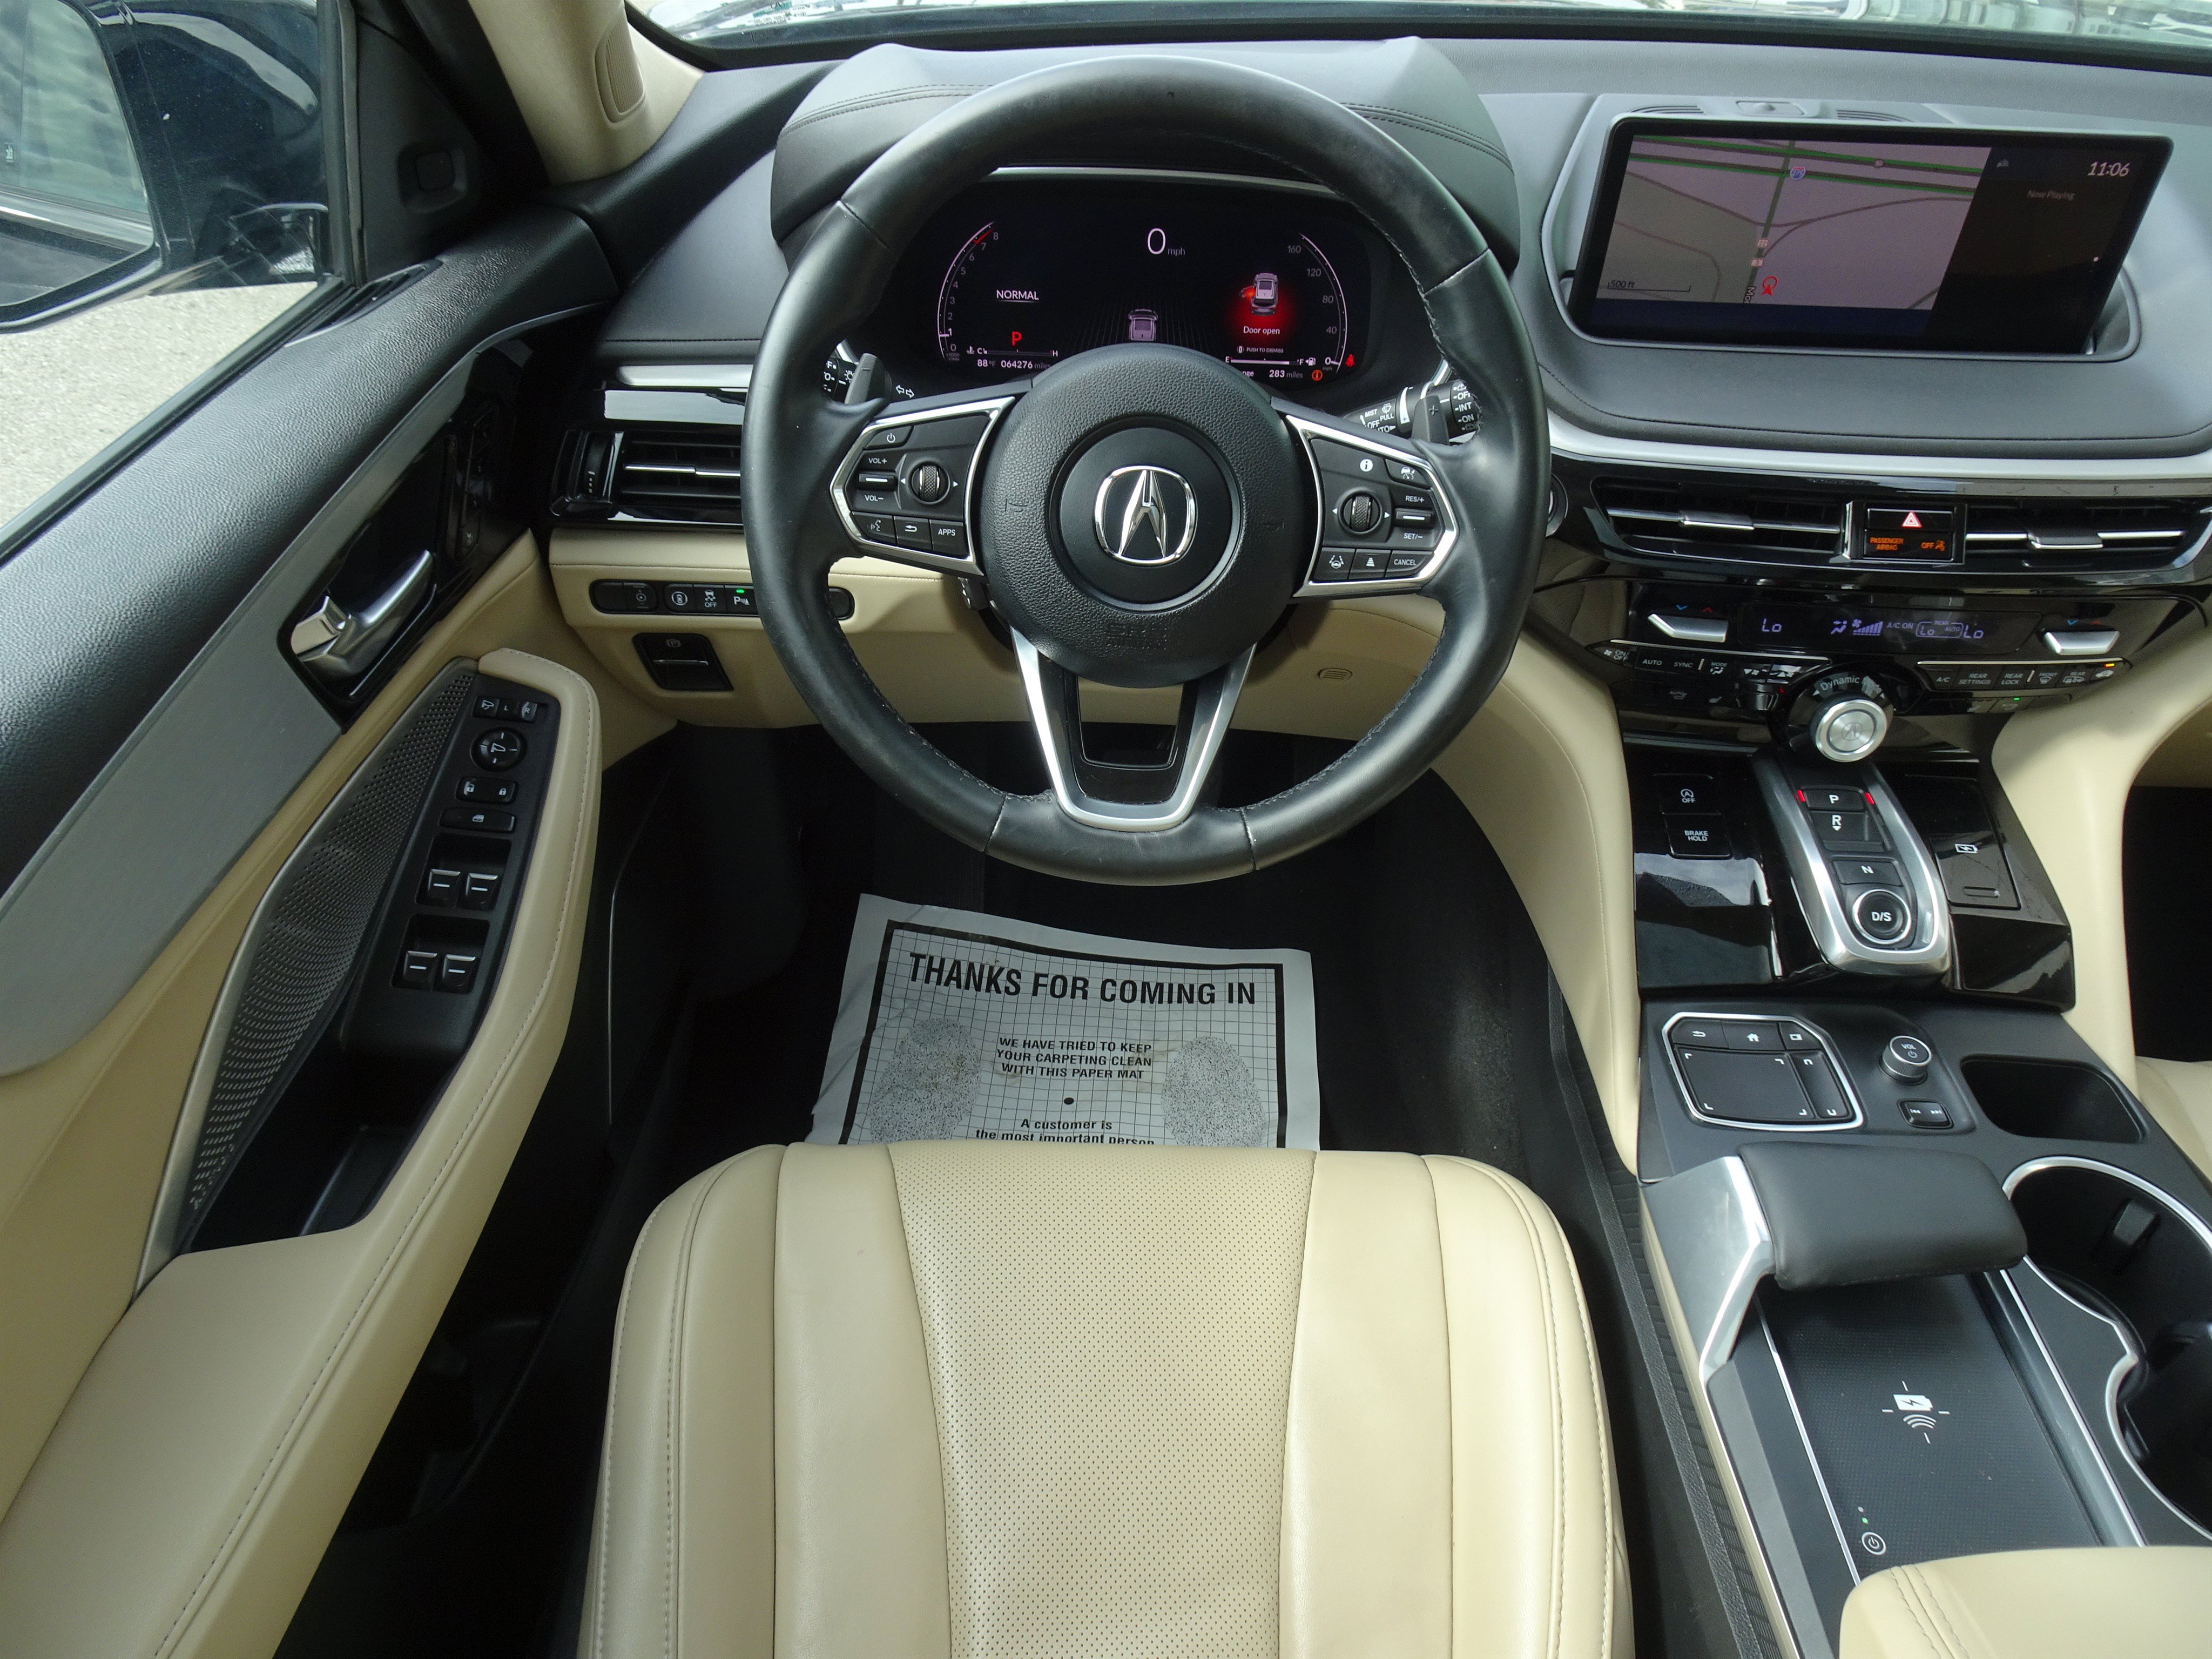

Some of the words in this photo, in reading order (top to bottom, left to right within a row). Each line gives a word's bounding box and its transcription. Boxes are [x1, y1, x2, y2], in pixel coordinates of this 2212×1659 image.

[2087, 161, 2131, 177] 11:06
[993, 232, 999, 240] 8
[981, 242, 986, 251] 7
[1147, 228, 1166, 254] 0
[1168, 246, 1185, 256] mph
[1287, 245, 1301, 254] 160
[969, 253, 974, 261] 6
[961, 267, 966, 275] 5
[1307, 268, 1321, 277] 120
[996, 289, 1039, 300] NORMAL
[1322, 295, 1334, 304] 80
[948, 328, 952, 336] 1
[1326, 326, 1337, 334] 40
[1011, 332, 1022, 346] P
[950, 343, 956, 352] 0
[1001, 360, 1033, 369] 064276
[1325, 356, 1331, 365] 0
[1459, 402, 1472, 412] INT
[1364, 409, 1378, 417] MIST
[1380, 414, 1394, 422] PULL
[1462, 414, 1474, 423] ON
[1367, 419, 1380, 429] OFF
[938, 528, 956, 536] APPS
[1762, 618, 1782, 632] Lo
[1820, 676, 1860, 691] Dynamic
[1829, 794, 1839, 804] P
[1832, 814, 1842, 826] R
[1861, 866, 1874, 874] N
[1871, 912, 1892, 922] D/S
[909, 952, 1022, 996] THANKS
[1031, 973, 1089, 1000] FOR
[1100, 978, 1216, 1004] COMING
[1227, 982, 1256, 1004] IN
[1000, 1037, 1019, 1048] WE
[1022, 1040, 1055, 1050] HAVE
[1059, 1041, 1096, 1051] TRIED
[1100, 1041, 1116, 1051] TO
[1120, 1042, 1152, 1053] KEEP
[996, 1049, 1031, 1062] YOUR
[1035, 1053, 1107, 1065] CARPETING
[1111, 1056, 1152, 1067] CLEAN
[1002, 1063, 1034, 1075] WITH
[1038, 1067, 1067, 1077] THIS
[1072, 1068, 1113, 1078] PAPER
[1117, 1070, 1145, 1080] MAT
[1020, 1119, 1030, 1129] A
[1034, 1120, 1097, 1130] customer
[1101, 1121, 1112, 1130] is
[976, 1129, 996, 1139] the
[1001, 1132, 1035, 1142] most
[1039, 1133, 1104, 1144] important
